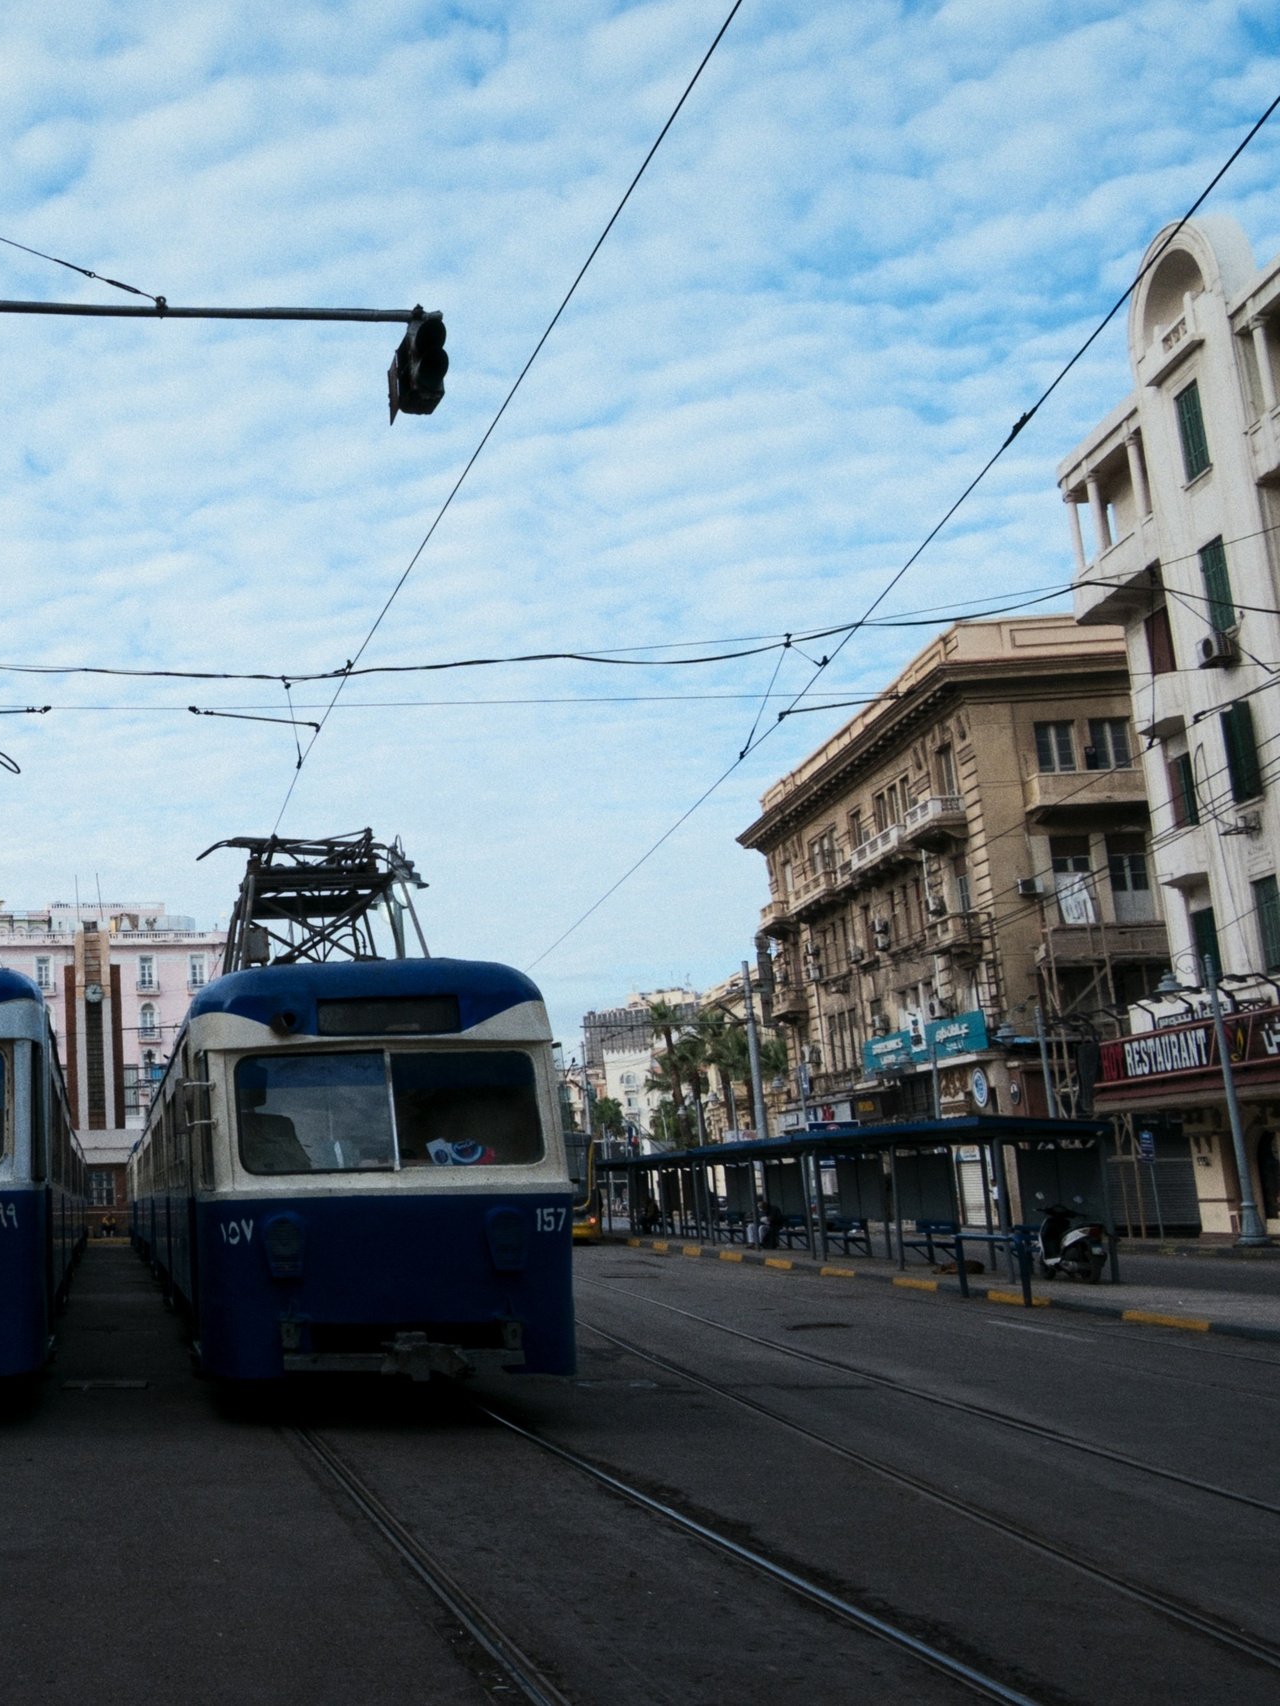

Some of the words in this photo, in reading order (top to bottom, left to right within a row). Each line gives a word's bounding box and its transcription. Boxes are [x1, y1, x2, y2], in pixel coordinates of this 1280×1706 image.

[1100, 1044, 1125, 1081] HOT
[1124, 1028, 1208, 1077] RESTAURANT
[220, 1218, 254, 1246] ١٥٧
[536, 1207, 567, 1232] 157
